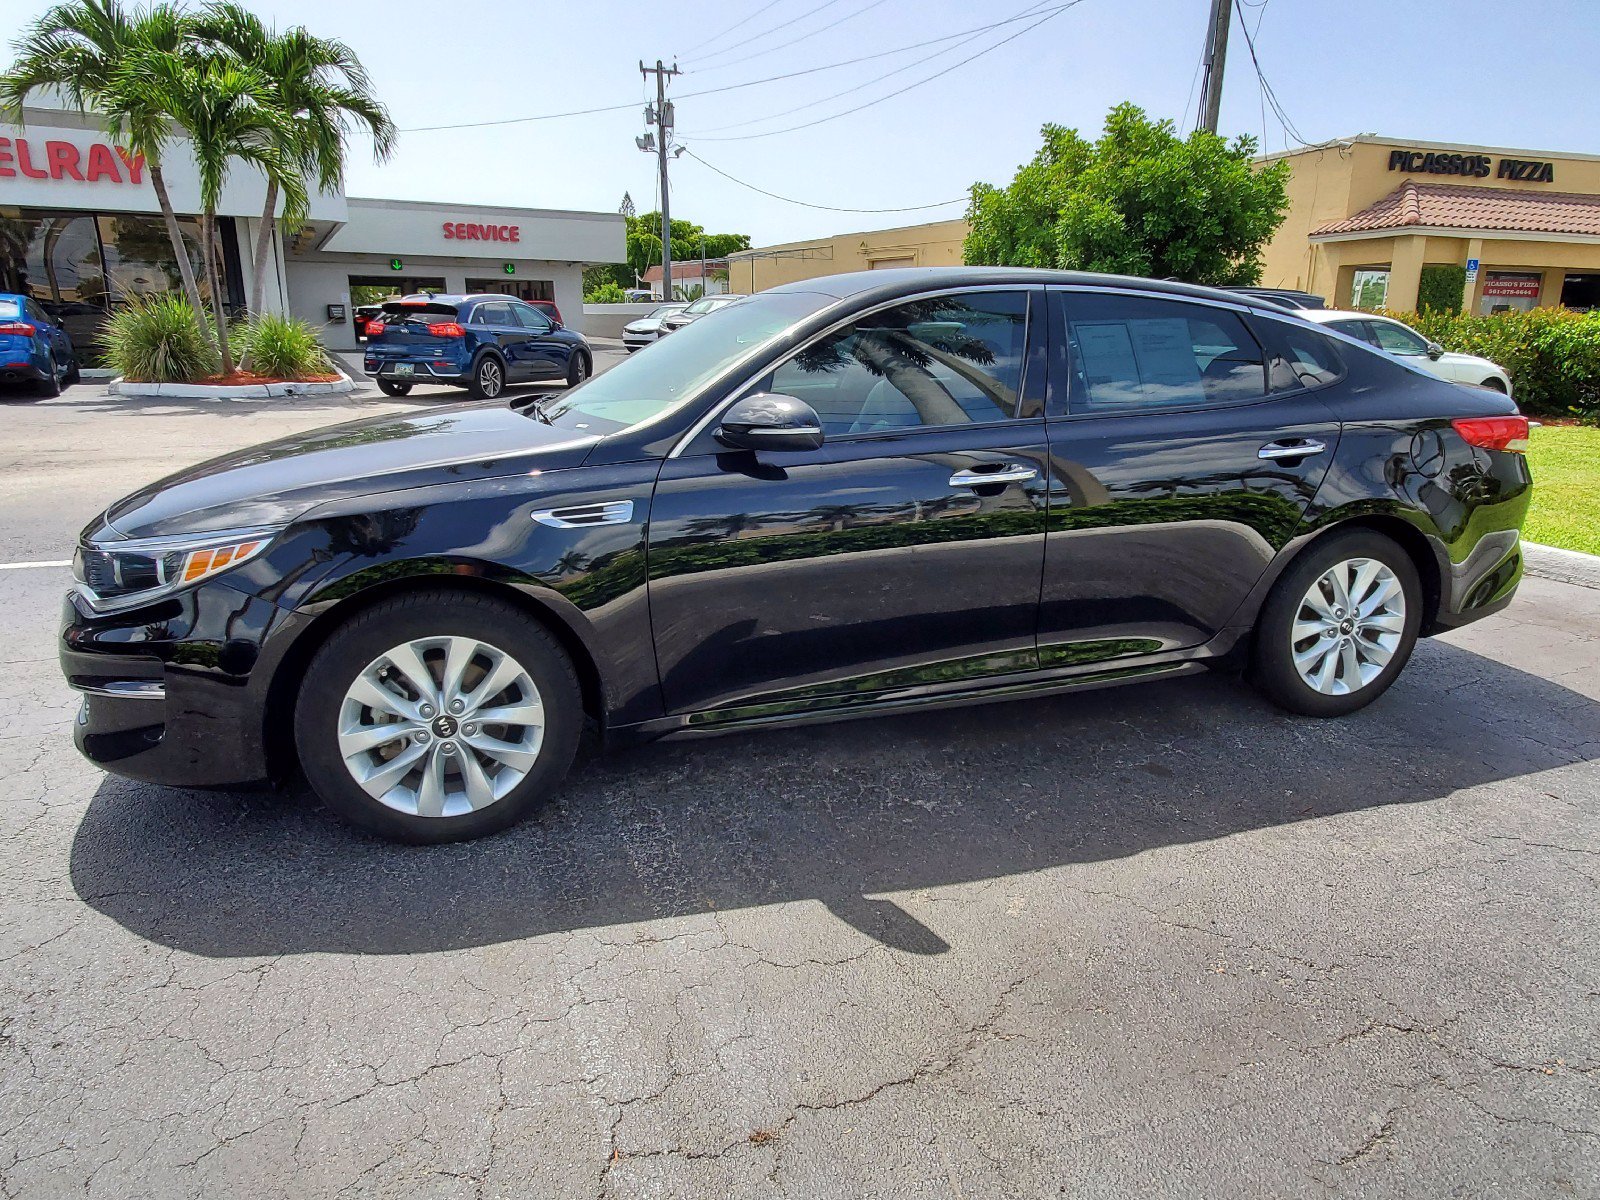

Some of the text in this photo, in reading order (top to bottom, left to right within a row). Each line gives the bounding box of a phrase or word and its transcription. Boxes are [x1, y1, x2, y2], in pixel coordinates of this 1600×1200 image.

[1498, 159, 1553, 182] PIZZA
[443, 222, 519, 242] SERVICE
[438, 717, 452, 736] KIA
